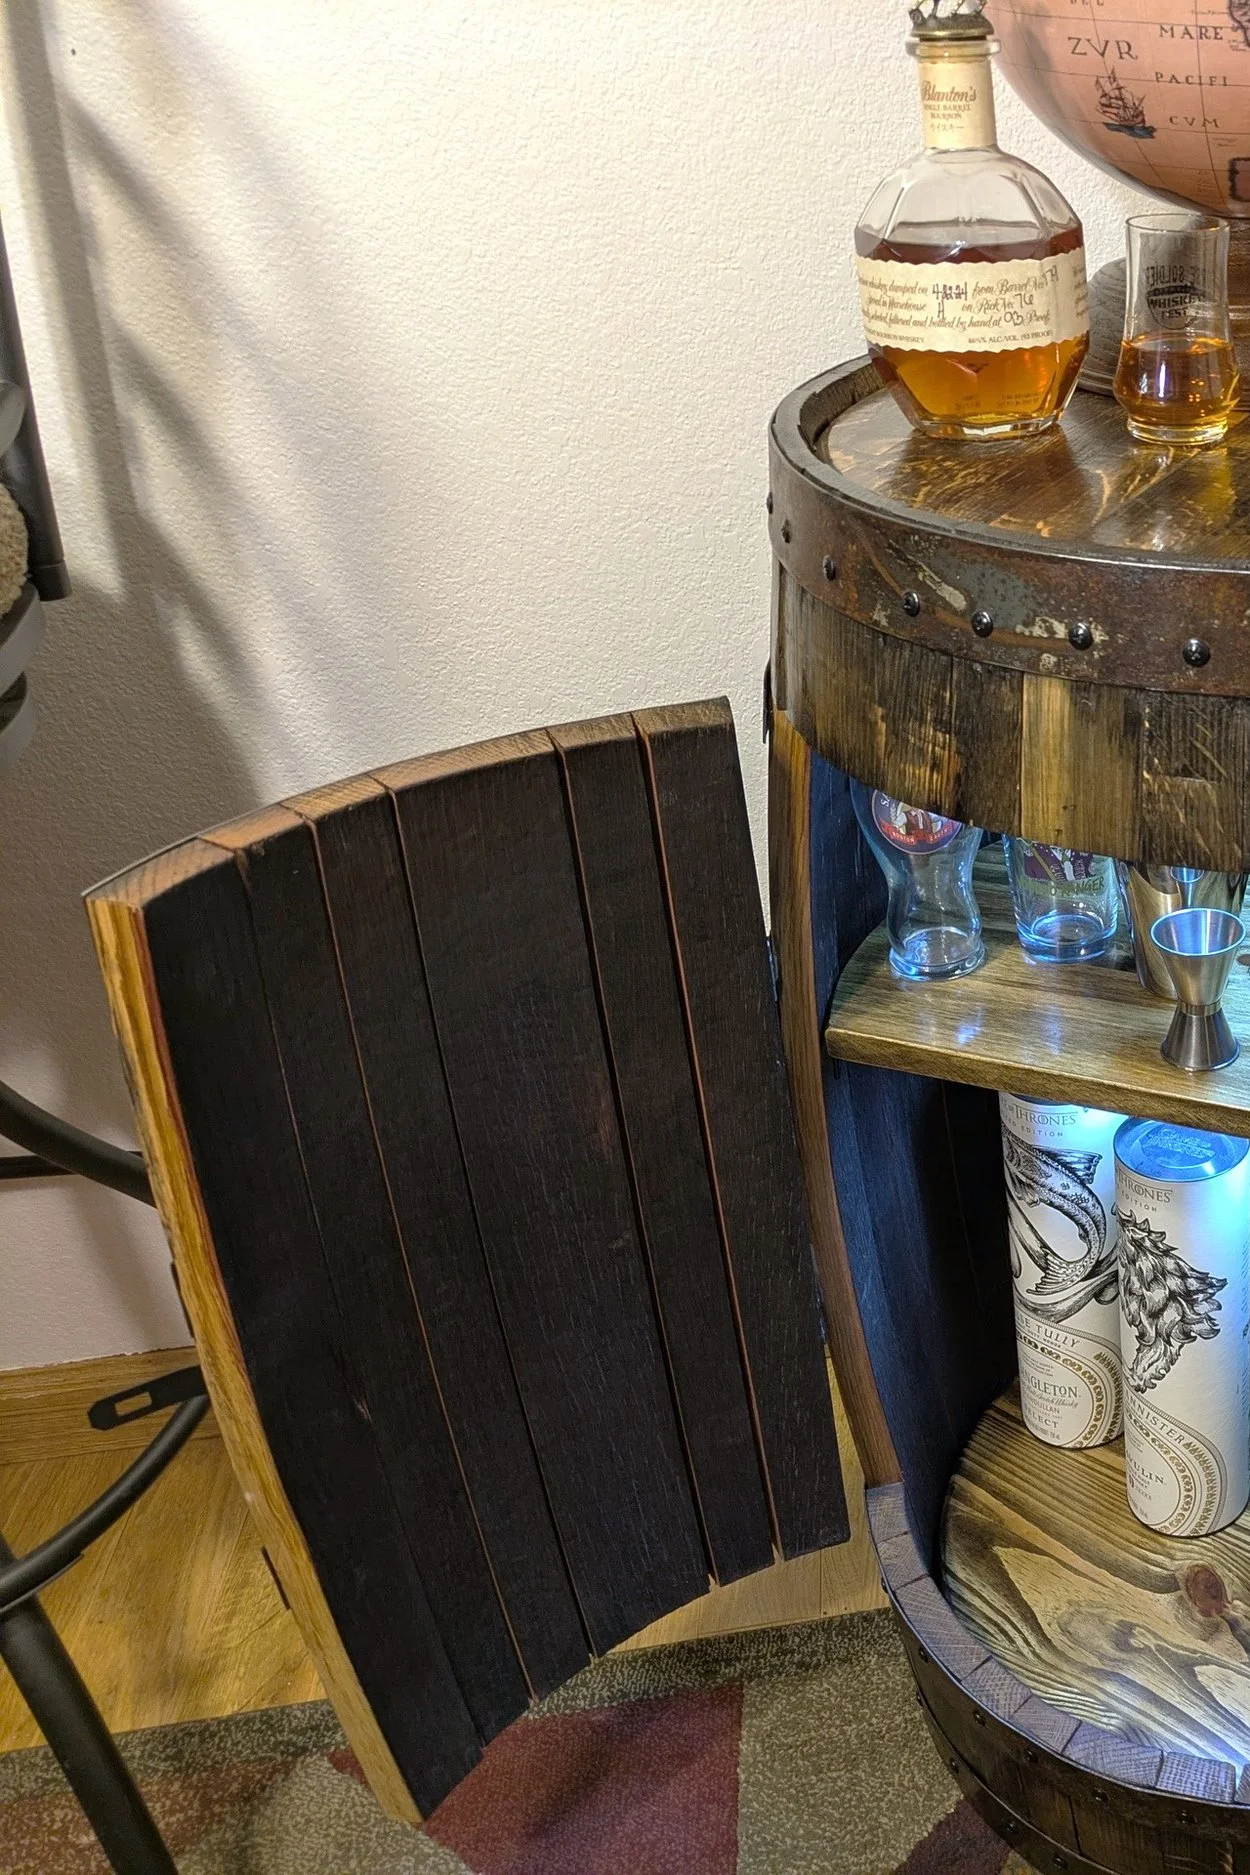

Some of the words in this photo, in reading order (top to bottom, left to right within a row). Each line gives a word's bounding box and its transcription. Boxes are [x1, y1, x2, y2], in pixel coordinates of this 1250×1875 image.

[1159, 24, 1223, 41] MARE
[1068, 36, 1138, 60] ZVR
[1155, 71, 1228, 87] PACIFI
[922, 80, 977, 102] Blanton's
[1169, 115, 1219, 128] CVM
[1014, 1103, 1077, 1126] THRONES
[1021, 1125, 1063, 1137] EDITION
[1121, 1190, 1157, 1212] EDITION
[1036, 1323, 1081, 1348] TULLY
